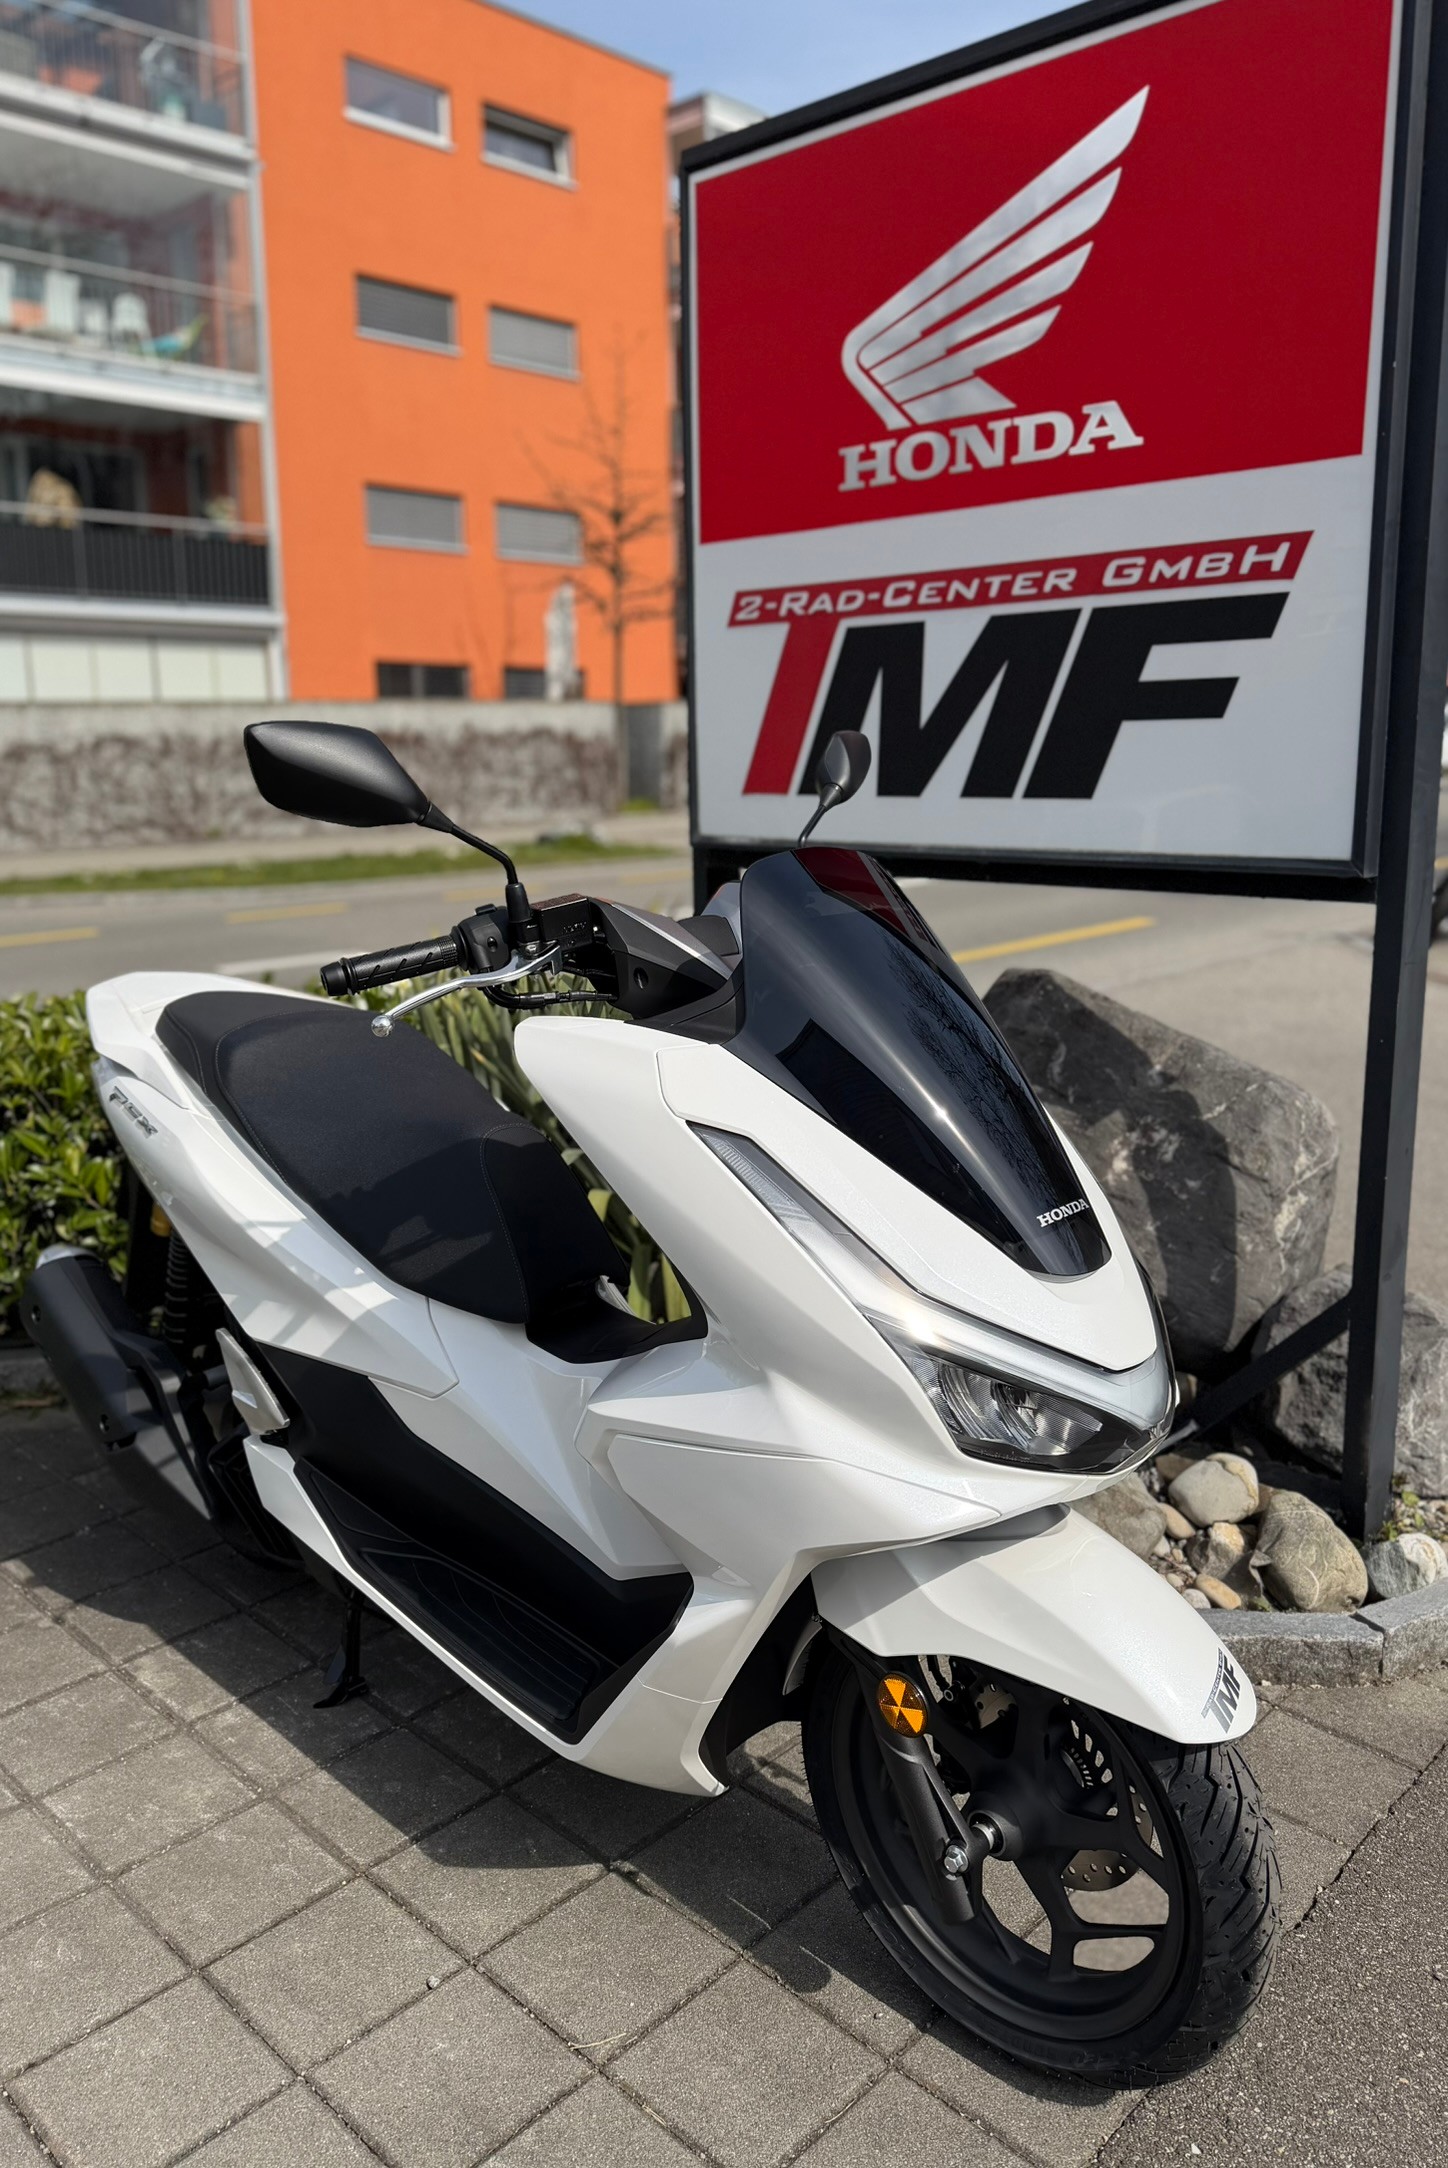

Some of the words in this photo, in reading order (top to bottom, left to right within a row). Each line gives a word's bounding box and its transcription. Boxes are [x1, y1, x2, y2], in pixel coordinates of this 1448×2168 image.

[838, 400, 1143, 492] HONDA
[741, 591, 1290, 800] TMF
[109, 1085, 159, 1138] PCX
[1036, 1198, 1090, 1228] HONDA
[1208, 1653, 1241, 1734] TMF
